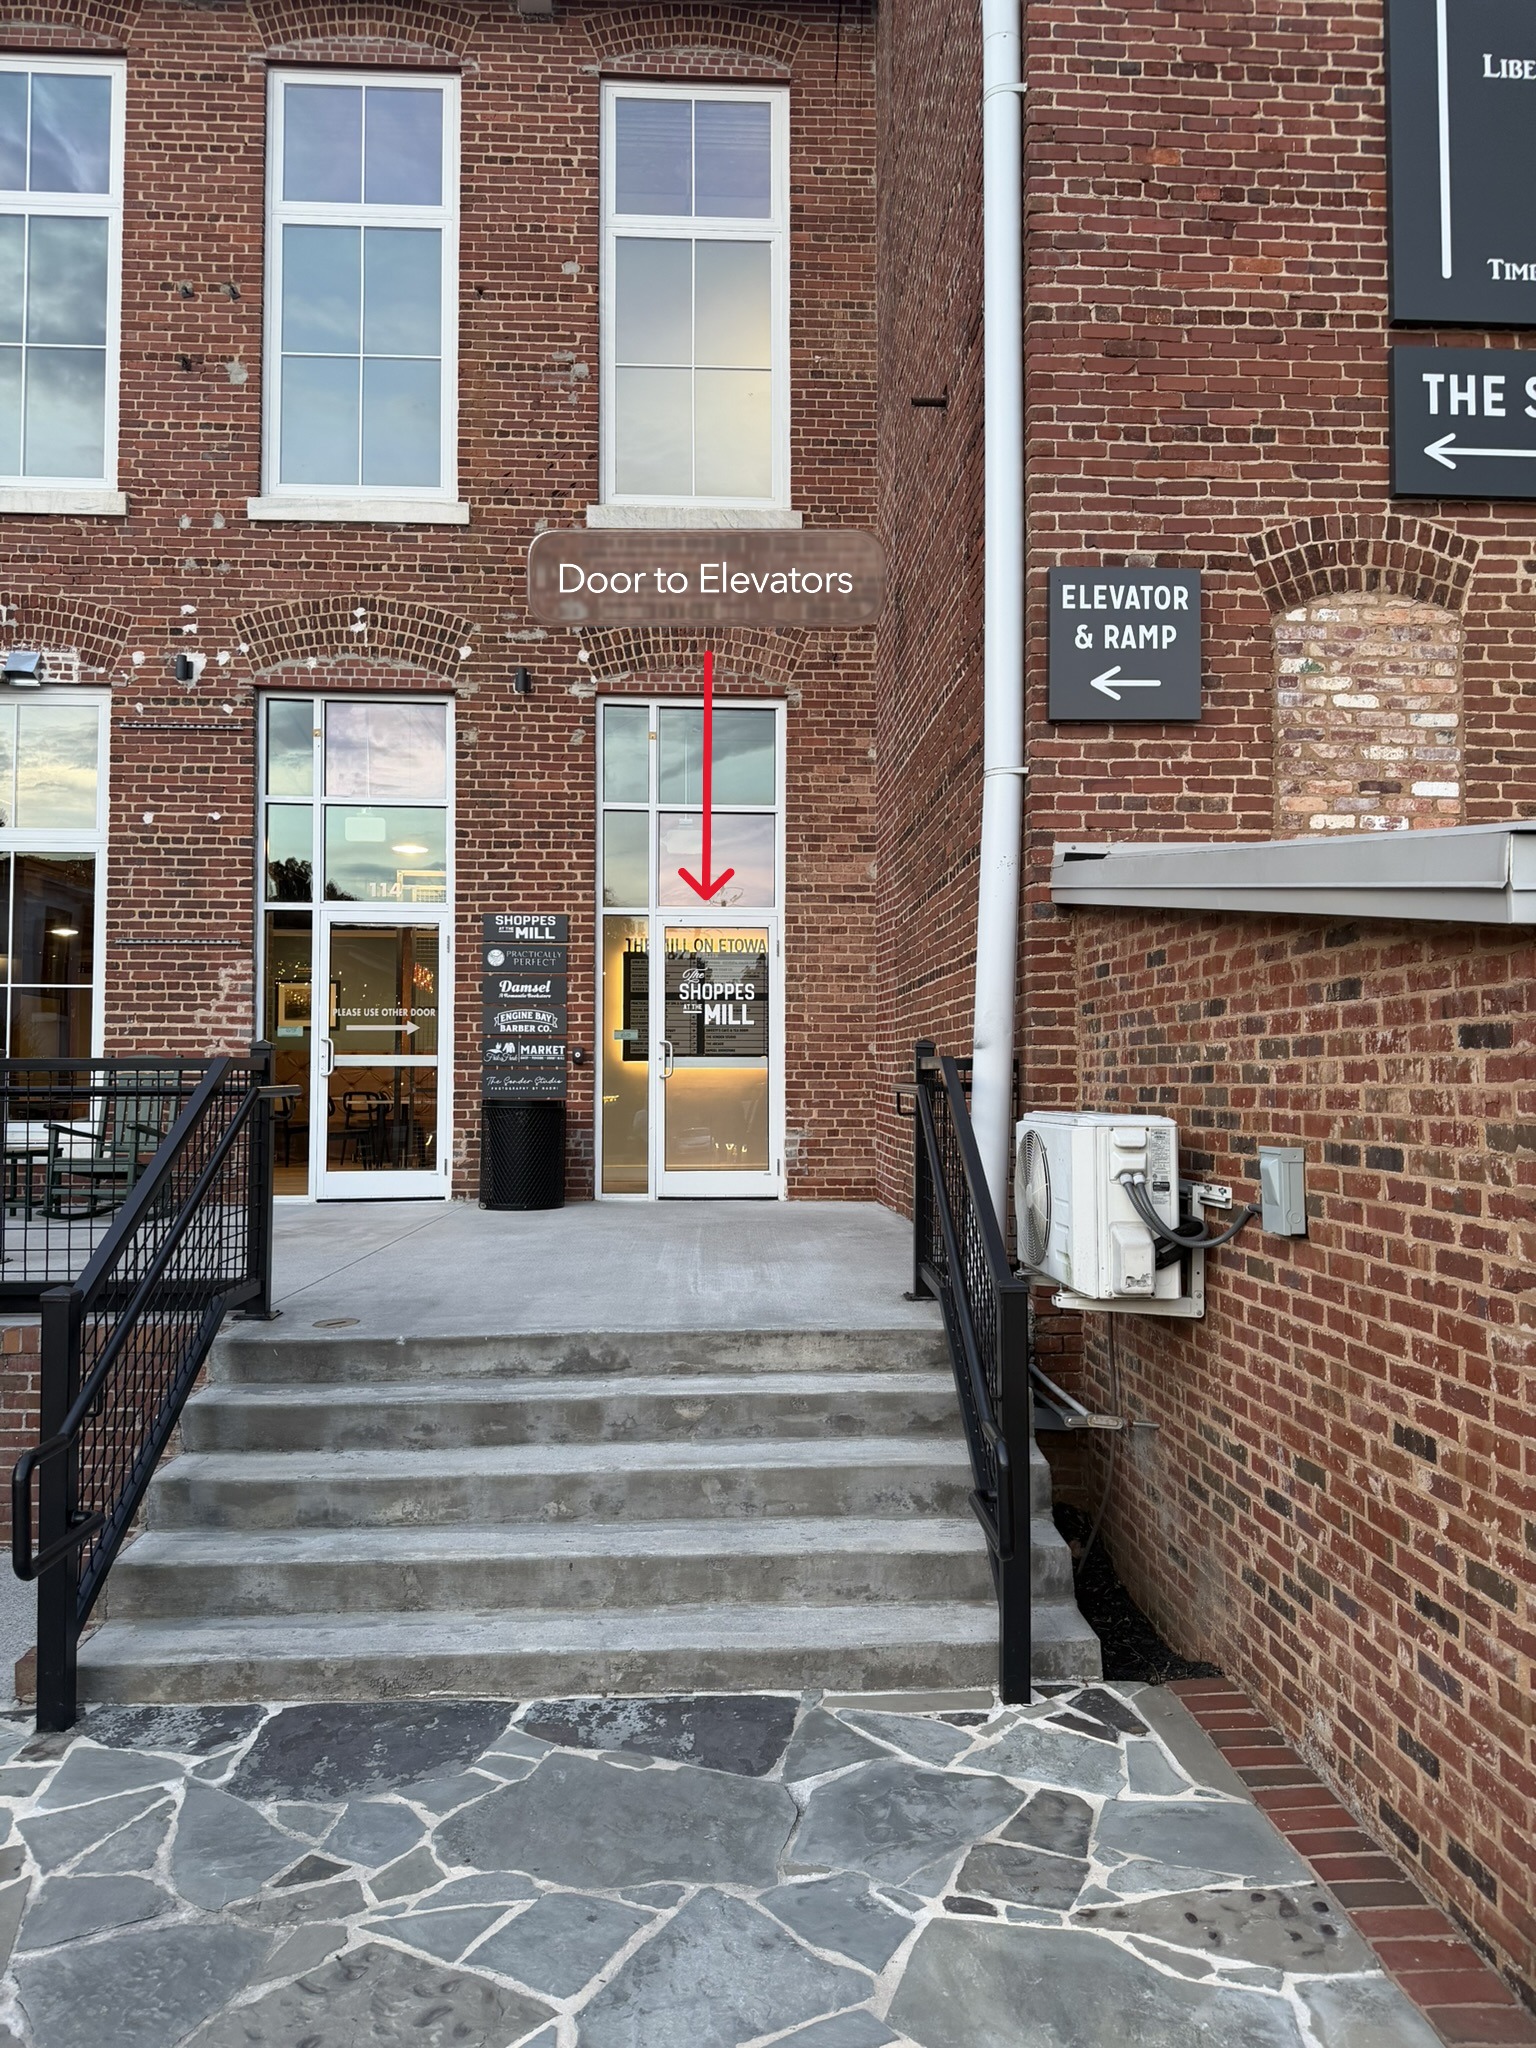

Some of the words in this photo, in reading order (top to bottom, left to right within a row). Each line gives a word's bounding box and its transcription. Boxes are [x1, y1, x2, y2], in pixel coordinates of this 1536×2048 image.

[1422, 373, 1506, 417] THE
[1062, 584, 1189, 610] ELEVATOR
[1074, 624, 1093, 649] &
[1104, 624, 1177, 649] RAMP
[369, 883, 402, 897] 114
[495, 915, 556, 926] SHOPPES
[515, 927, 556, 939] MILL
[694, 938, 713, 953] ON
[513, 958, 557, 966] PERFECT
[682, 967, 708, 984] The
[499, 980, 551, 993] Damsel
[679, 983, 755, 1000] SHOPPES
[332, 1008, 361, 1017] PLEASE
[363, 1008, 379, 1017] USE
[381, 1008, 409, 1017] OTHER
[410, 1008, 436, 1017] DOOR
[500, 1011, 533, 1022] ENGINE
[535, 1012, 552, 1022] BAY
[704, 1004, 755, 1025] MILL
[520, 1045, 566, 1055] MARKET
[486, 1076, 502, 1086] The
[534, 1076, 563, 1086] Studio
